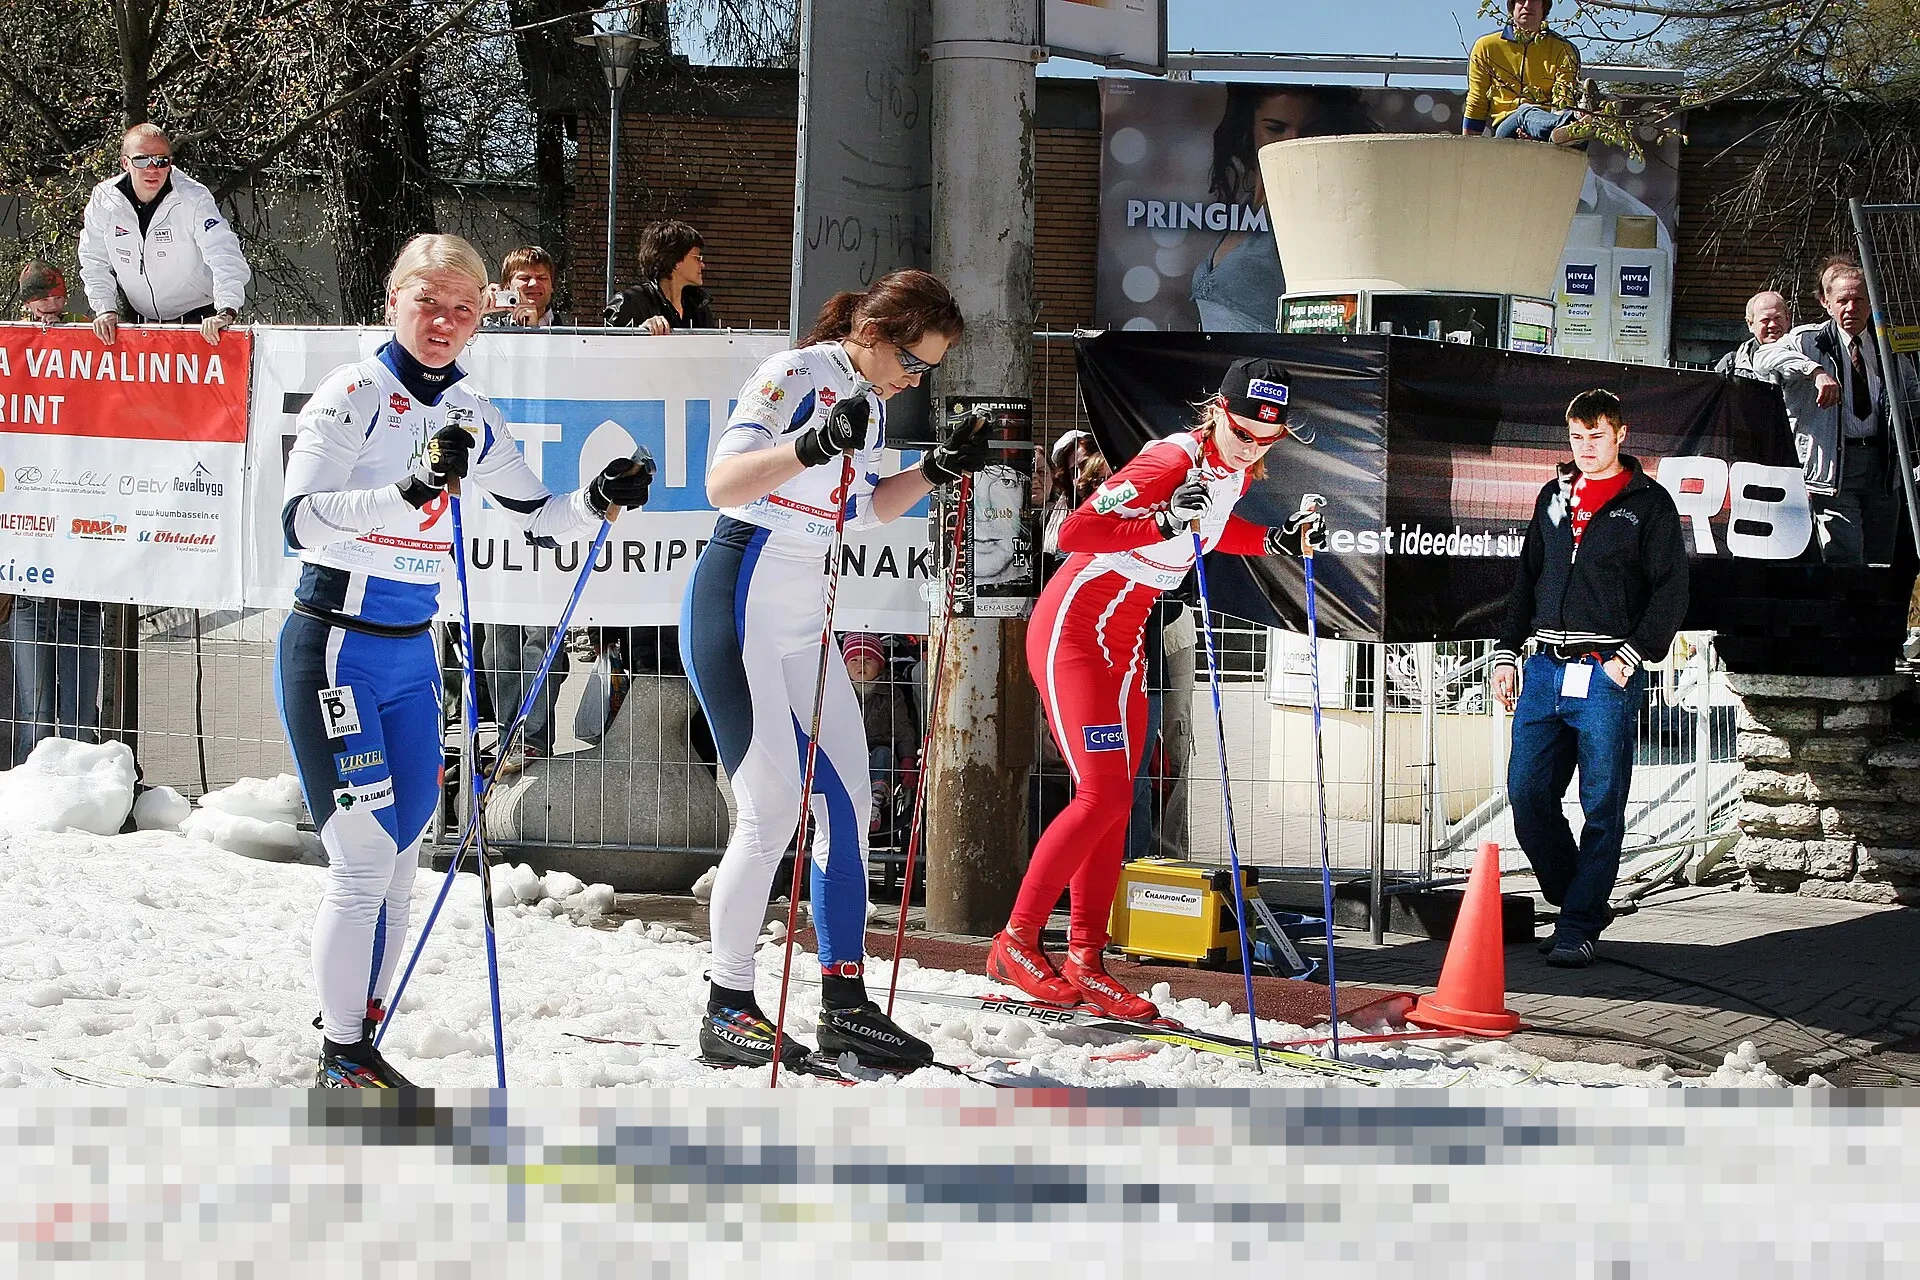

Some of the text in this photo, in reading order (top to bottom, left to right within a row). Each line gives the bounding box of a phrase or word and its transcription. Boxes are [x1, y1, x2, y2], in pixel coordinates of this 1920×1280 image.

[127, 199, 269, 233] PRINGIM
[1567, 273, 1594, 281] NIVEA
[1622, 274, 1649, 282] NIVEA
[1572, 282, 1589, 290] body
[1626, 284, 1643, 292] body
[1289, 304, 1345, 317] Kogu perega
[1568, 309, 1591, 317] Beauty
[1623, 310, 1646, 318] Beauty
[1289, 315, 1343, 330] loomaaeda!
[25, 347, 226, 386] VANALINNA
[1252, 381, 1283, 398] Cresco
[137, 478, 169, 494] etv
[172, 476, 224, 497] Revalbygg
[1098, 487, 1136, 513] Leca
[135, 508, 220, 520] www.kuumbassein.ee
[418, 489, 449, 533] 9
[71, 518, 113, 536] STAR
[379, 537, 395, 545] COQ
[1399, 523, 1492, 558] ideedest
[393, 556, 442, 574] START
[1013, 553, 1025, 567] 12
[332, 723, 359, 735] PROJEKT
[339, 750, 384, 770] VIRTEL
[1006, 946, 1045, 979] alpina
[1078, 975, 1123, 1001] alpina
[980, 1001, 1075, 1023] FISCHER
[711, 1024, 783, 1052] SALOMON
[831, 1016, 907, 1047] SALOMON
